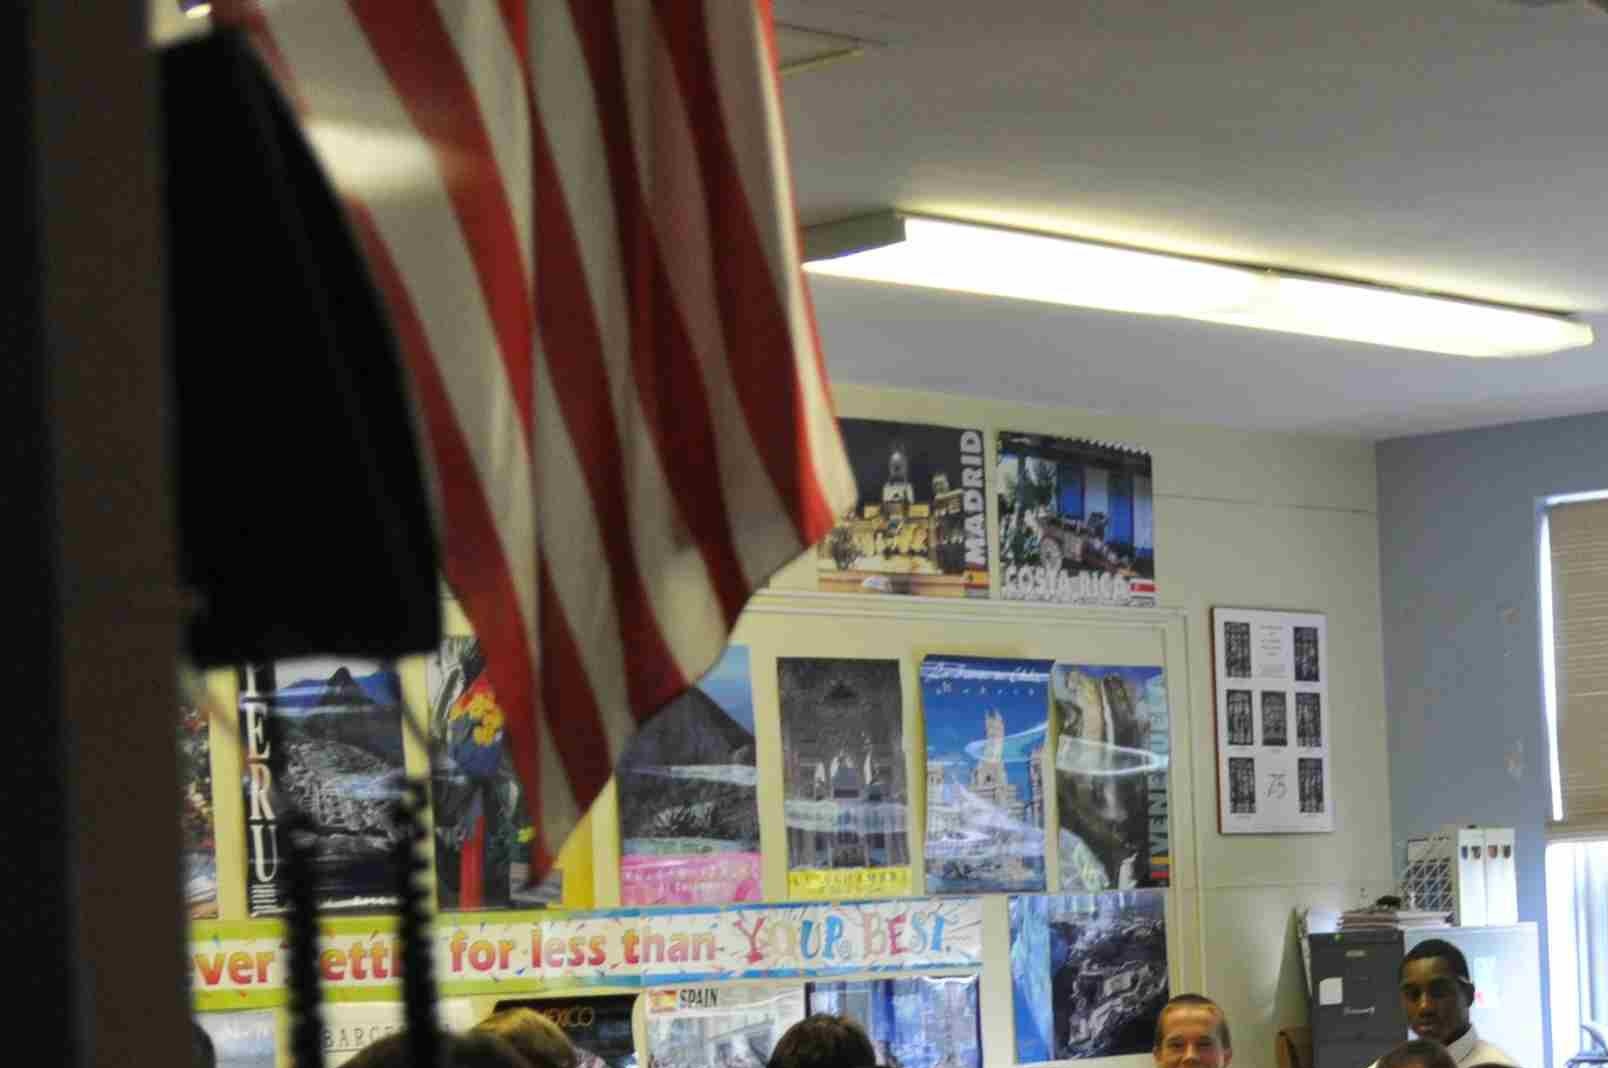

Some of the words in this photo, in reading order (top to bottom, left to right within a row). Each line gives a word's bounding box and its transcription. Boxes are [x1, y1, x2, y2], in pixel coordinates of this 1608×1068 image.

[961, 431, 986, 565] MADRID
[1005, 566, 1071, 598] COSTA
[1079, 571, 1127, 600] RICA
[193, 950, 275, 986] ver
[450, 928, 514, 972] for
[531, 928, 607, 968] less
[622, 928, 717, 966] than
[680, 988, 719, 1008] SPAIN
